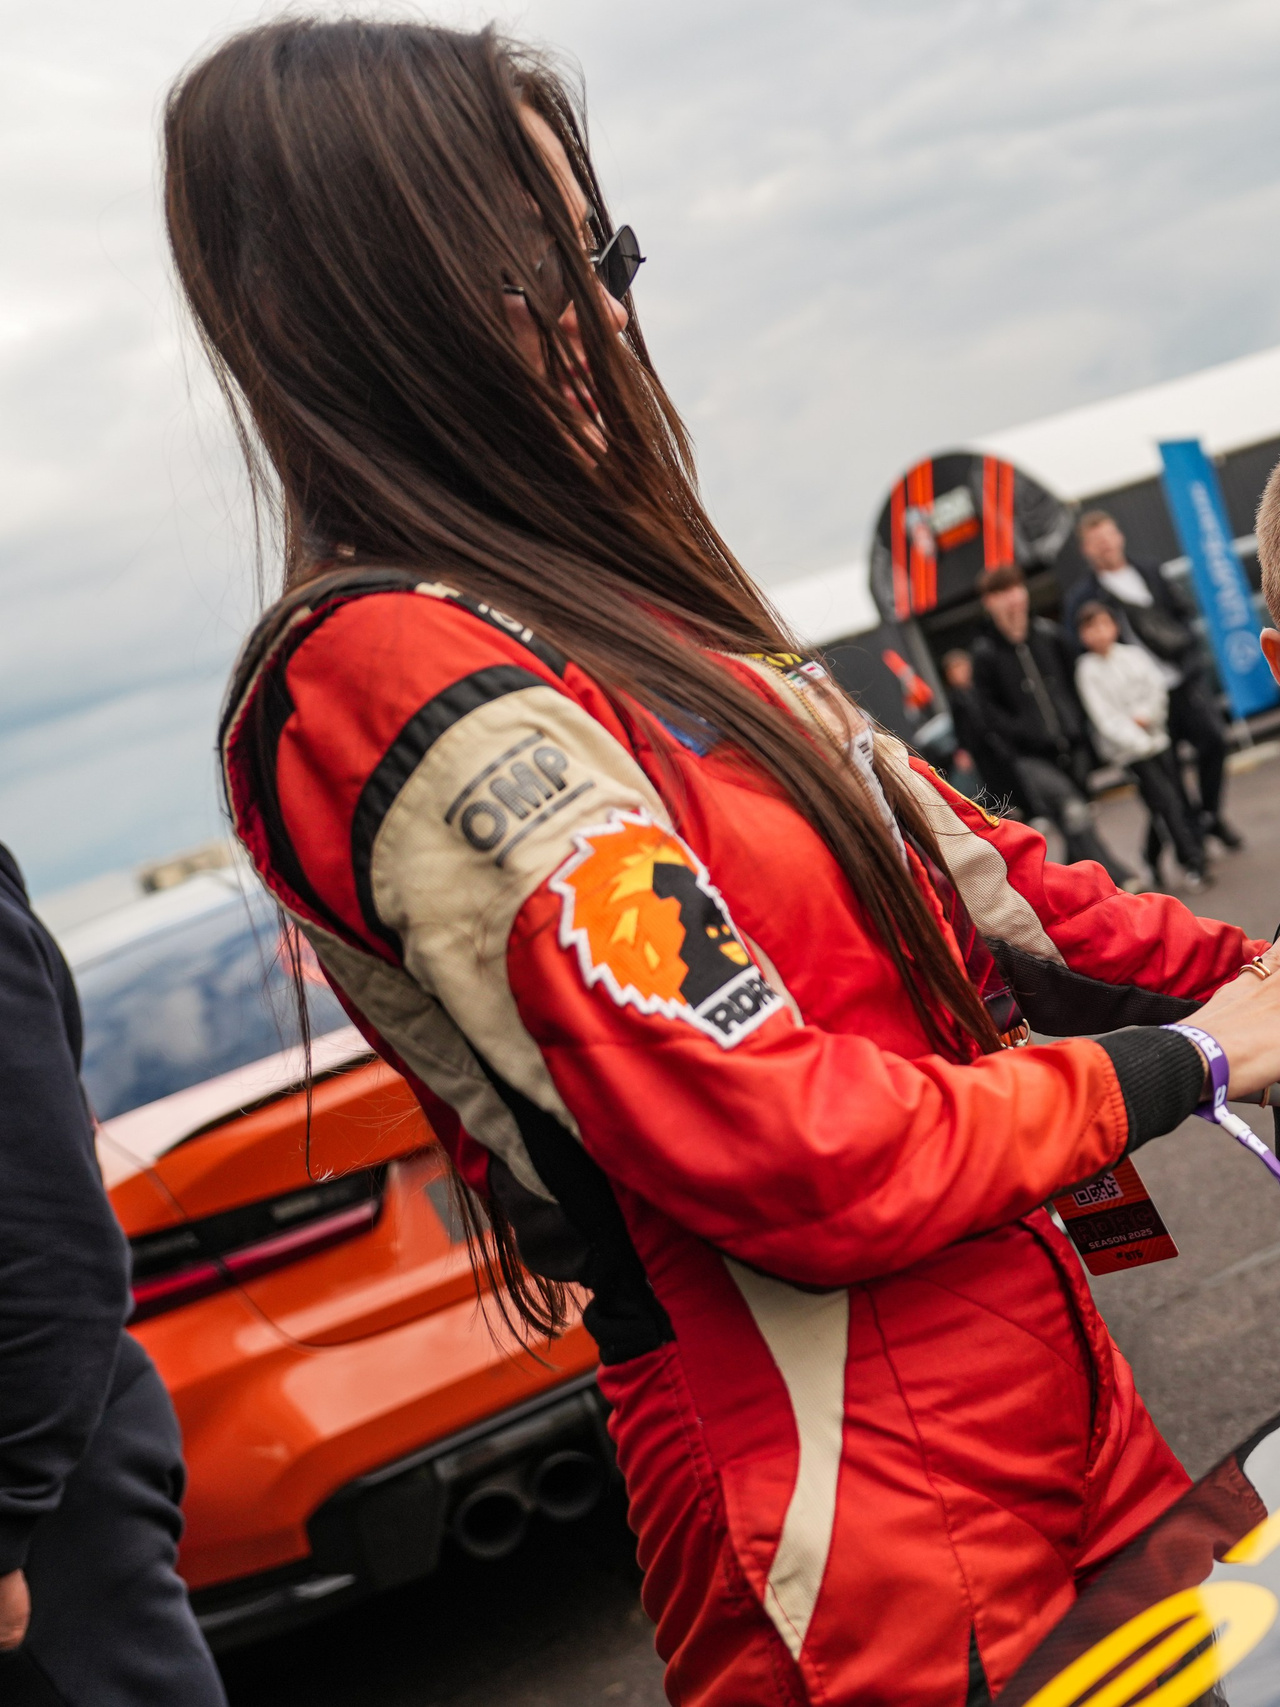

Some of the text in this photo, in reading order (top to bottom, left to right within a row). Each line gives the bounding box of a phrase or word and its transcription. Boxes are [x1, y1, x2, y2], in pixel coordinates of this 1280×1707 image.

[461, 746, 568, 852] OMP
[1089, 1227, 1153, 1250] SEASON 2025
